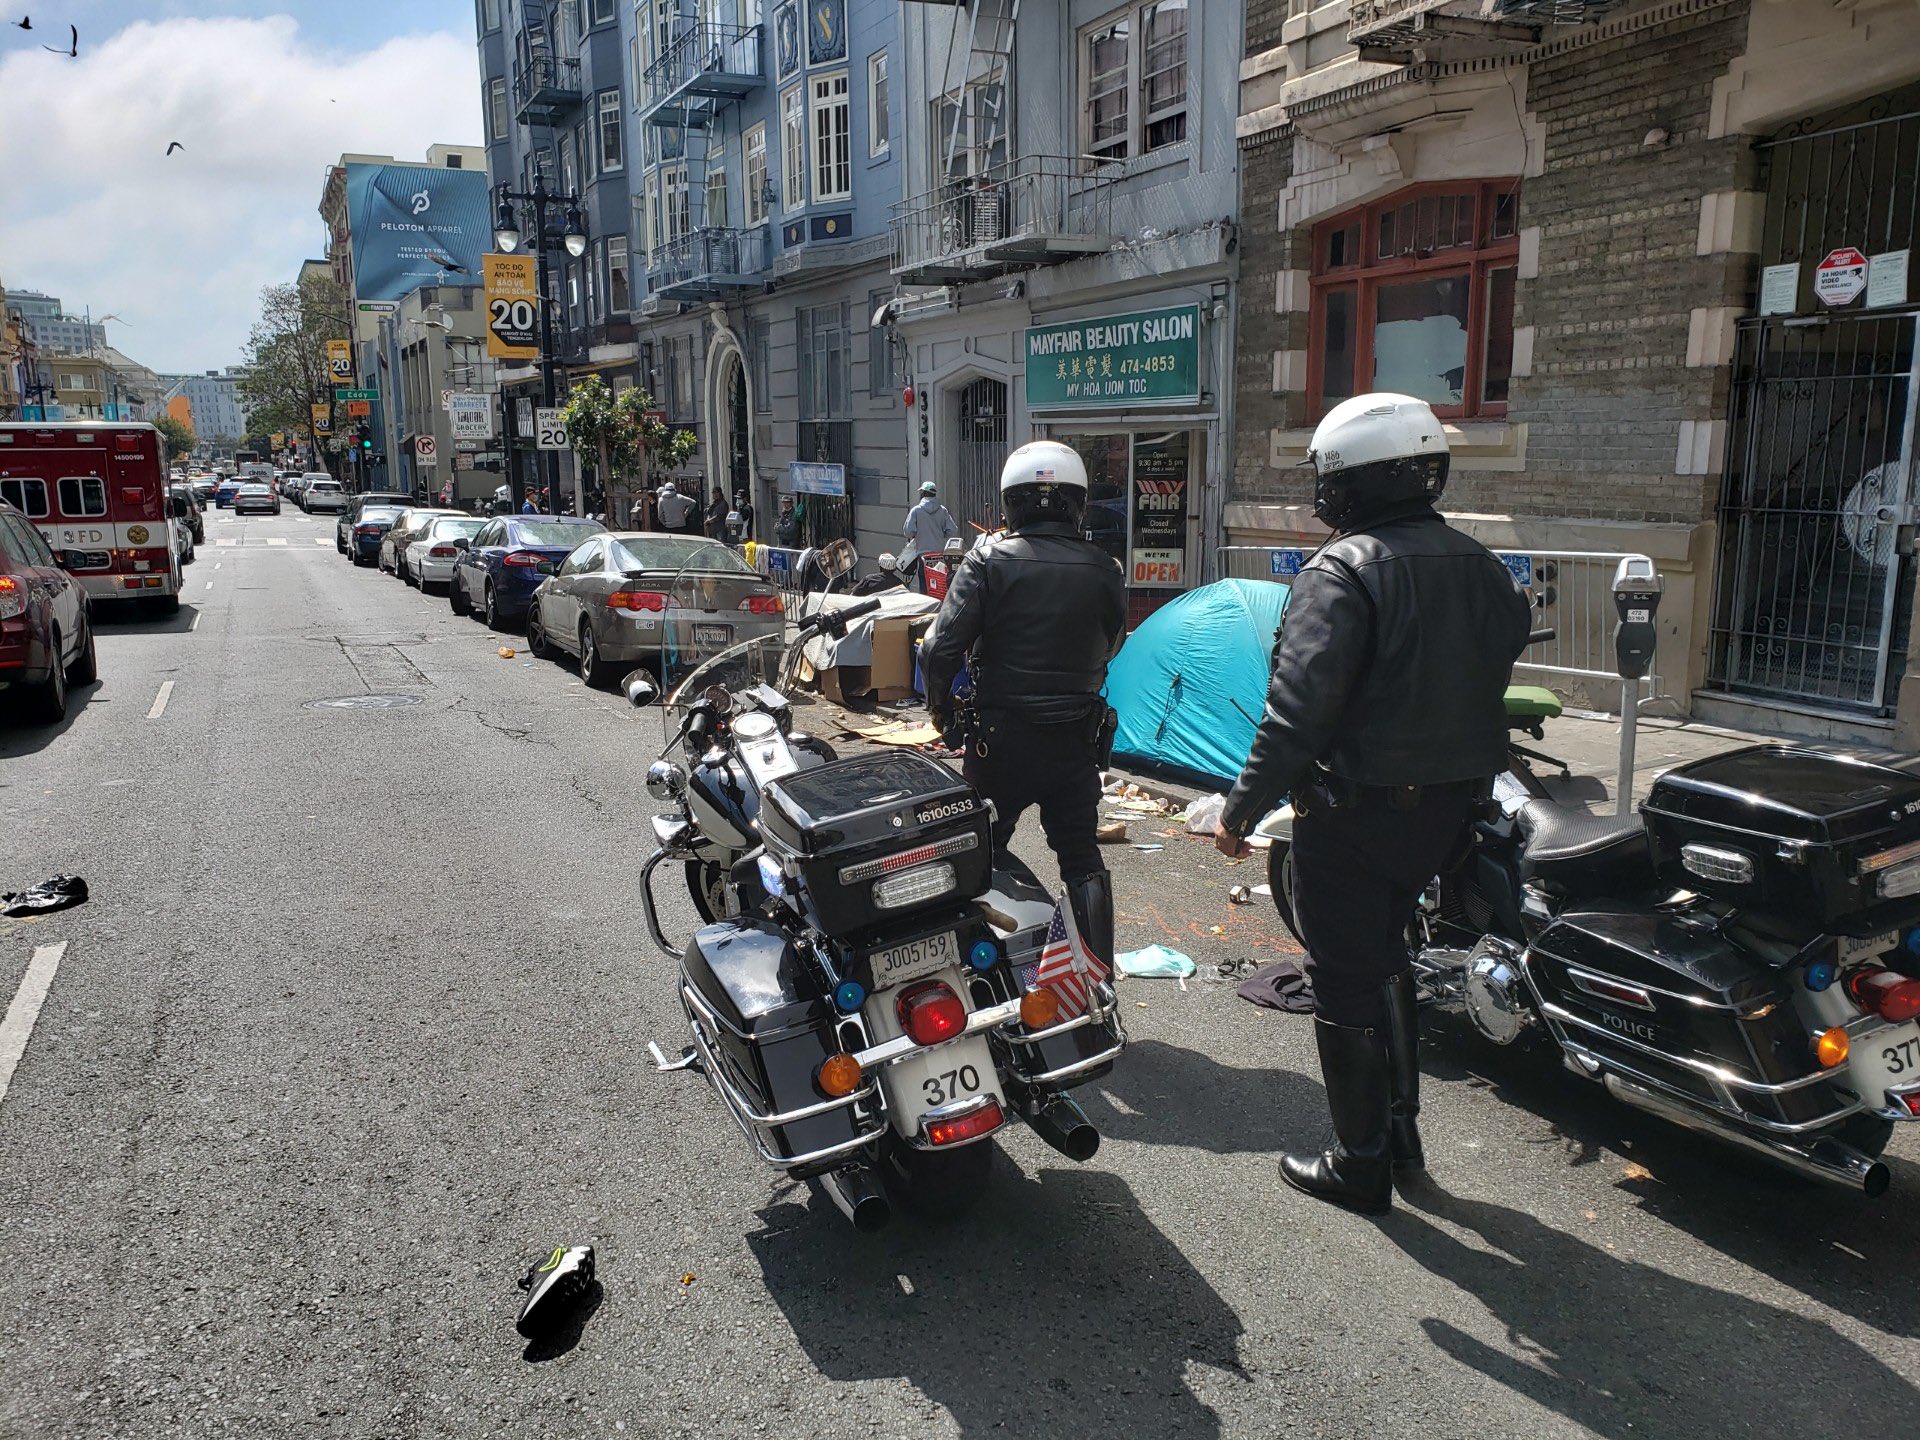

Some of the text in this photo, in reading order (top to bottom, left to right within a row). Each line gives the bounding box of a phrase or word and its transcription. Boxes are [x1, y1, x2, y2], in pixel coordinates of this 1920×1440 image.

[381, 222, 463, 234] PELOTON APPAREL
[1834, 258, 1851, 266] ALERT
[1820, 282, 1852, 290] SURVEILLANCE
[491, 299, 533, 330] 20
[1030, 313, 1193, 356] MAYFAIR BEAUTY SALON
[331, 359, 350, 372] 20
[1120, 355, 1175, 375] 474-4853
[1067, 378, 1147, 398] MY HOA UON TOC
[347, 391, 368, 399] Eddy
[457, 411, 485, 424] LIQUOR
[539, 412, 567, 420] SPEE
[315, 418, 329, 428] 20
[541, 430, 567, 446] 20
[1152, 451, 1168, 459] Open
[1174, 459, 1184, 467] pm
[1138, 493, 1180, 510] FAIR
[1150, 519, 1169, 527] Closed
[1141, 526, 1177, 535] Wednesdays
[1134, 561, 1181, 582] OPEN
[916, 799, 974, 824] 16100533
[1904, 800, 1920, 814] 161
[882, 935, 946, 972] 3005759
[1602, 1012, 1656, 1041] POLICE
[922, 1064, 980, 1106] 370
